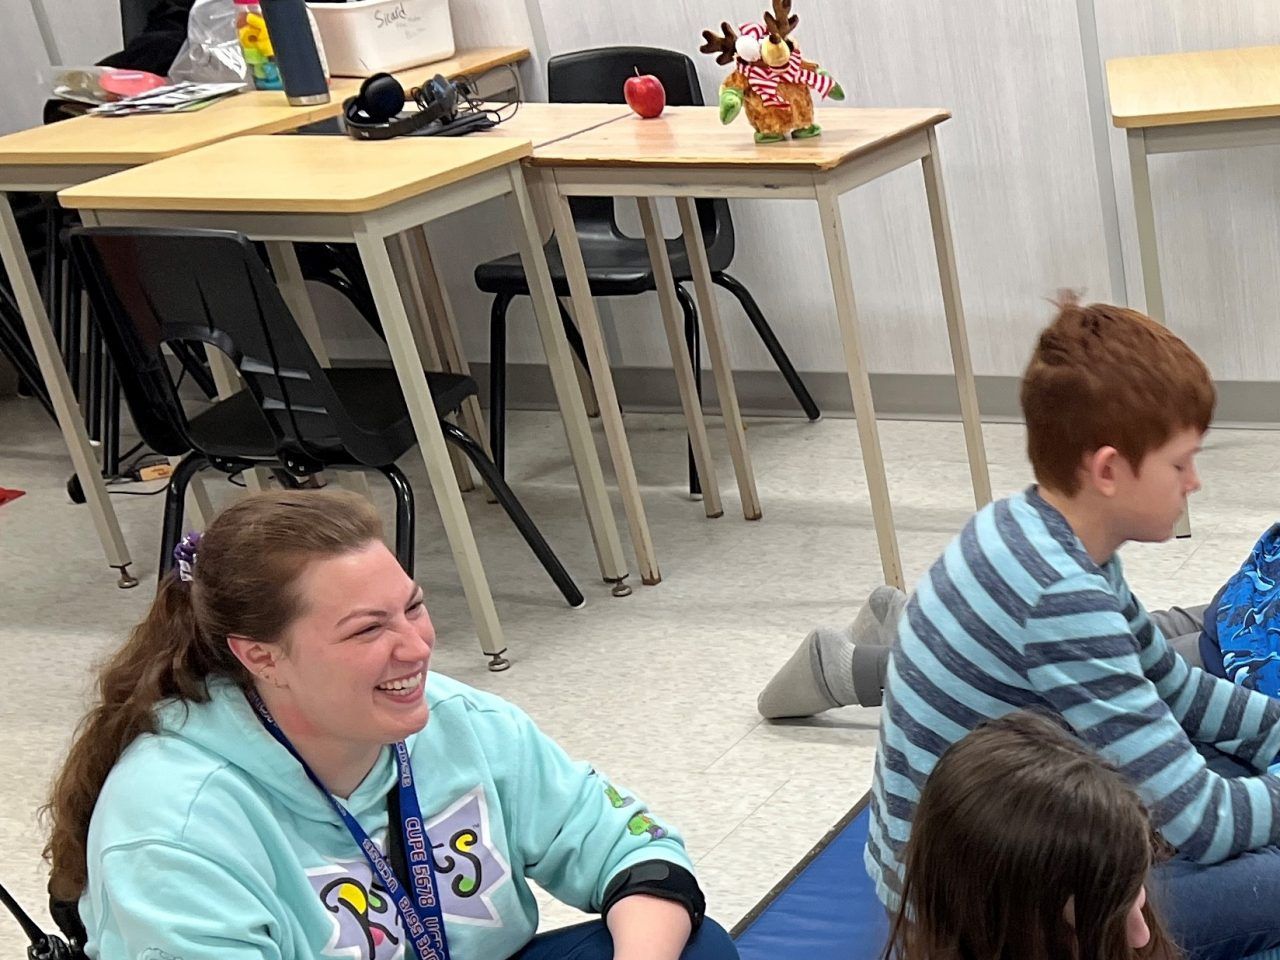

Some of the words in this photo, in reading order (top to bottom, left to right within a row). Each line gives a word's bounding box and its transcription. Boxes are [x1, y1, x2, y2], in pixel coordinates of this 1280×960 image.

[395, 741, 413, 788] CDSB
[404, 816, 427, 862] CUPE
[361, 838, 399, 894] UCDSB
[413, 864, 436, 908] 5678
[398, 895, 425, 938] 5678
